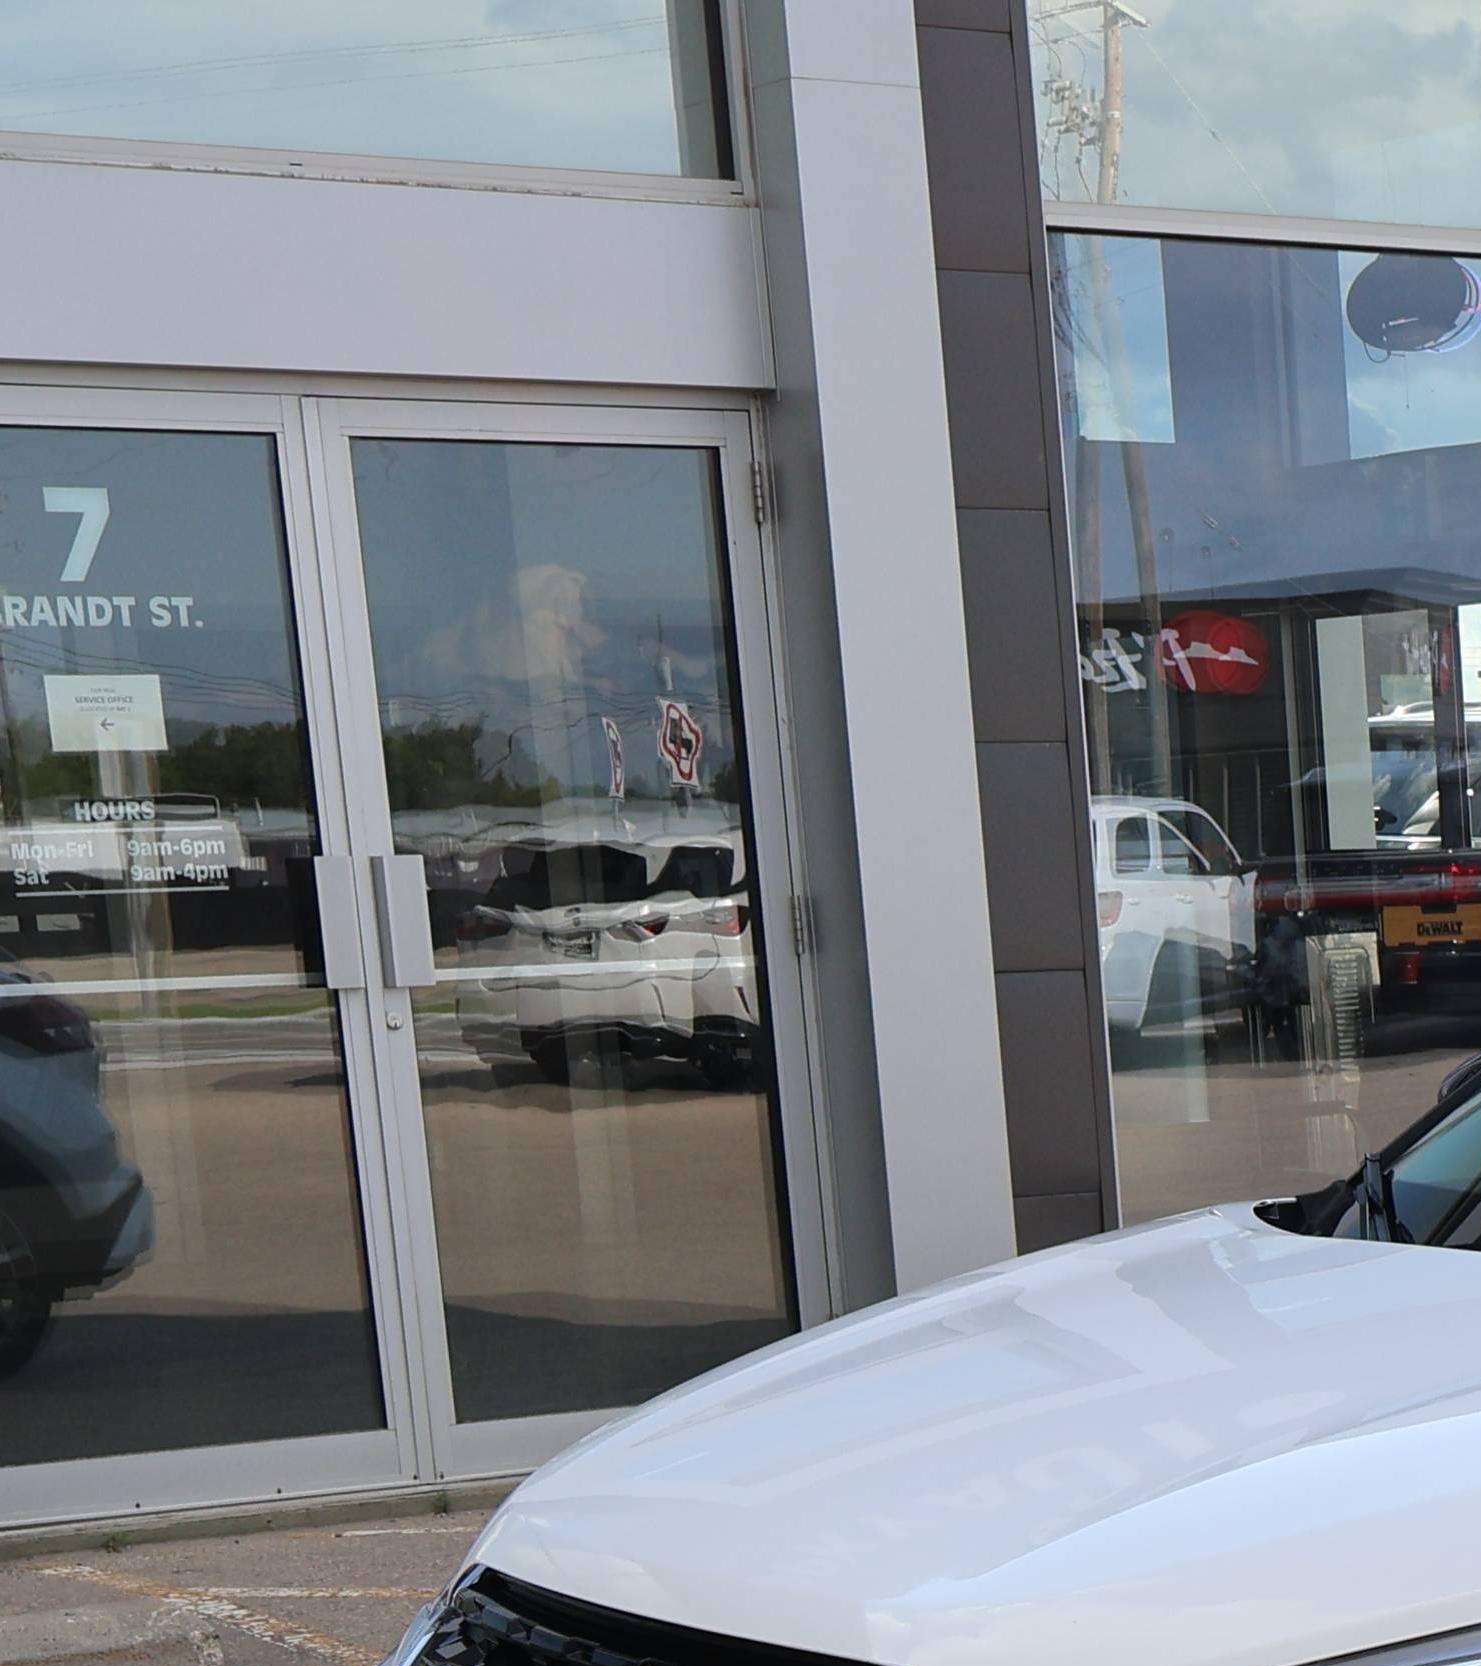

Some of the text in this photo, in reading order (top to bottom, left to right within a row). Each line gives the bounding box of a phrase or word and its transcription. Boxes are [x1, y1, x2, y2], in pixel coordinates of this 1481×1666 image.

[42, 486, 110, 582] 7
[0, 596, 204, 627] RANDT ST.
[74, 801, 155, 822] HOURS
[11, 838, 226, 860] Mon-Fri 9am-6pm
[14, 862, 229, 886] Sat 9am-4pm
